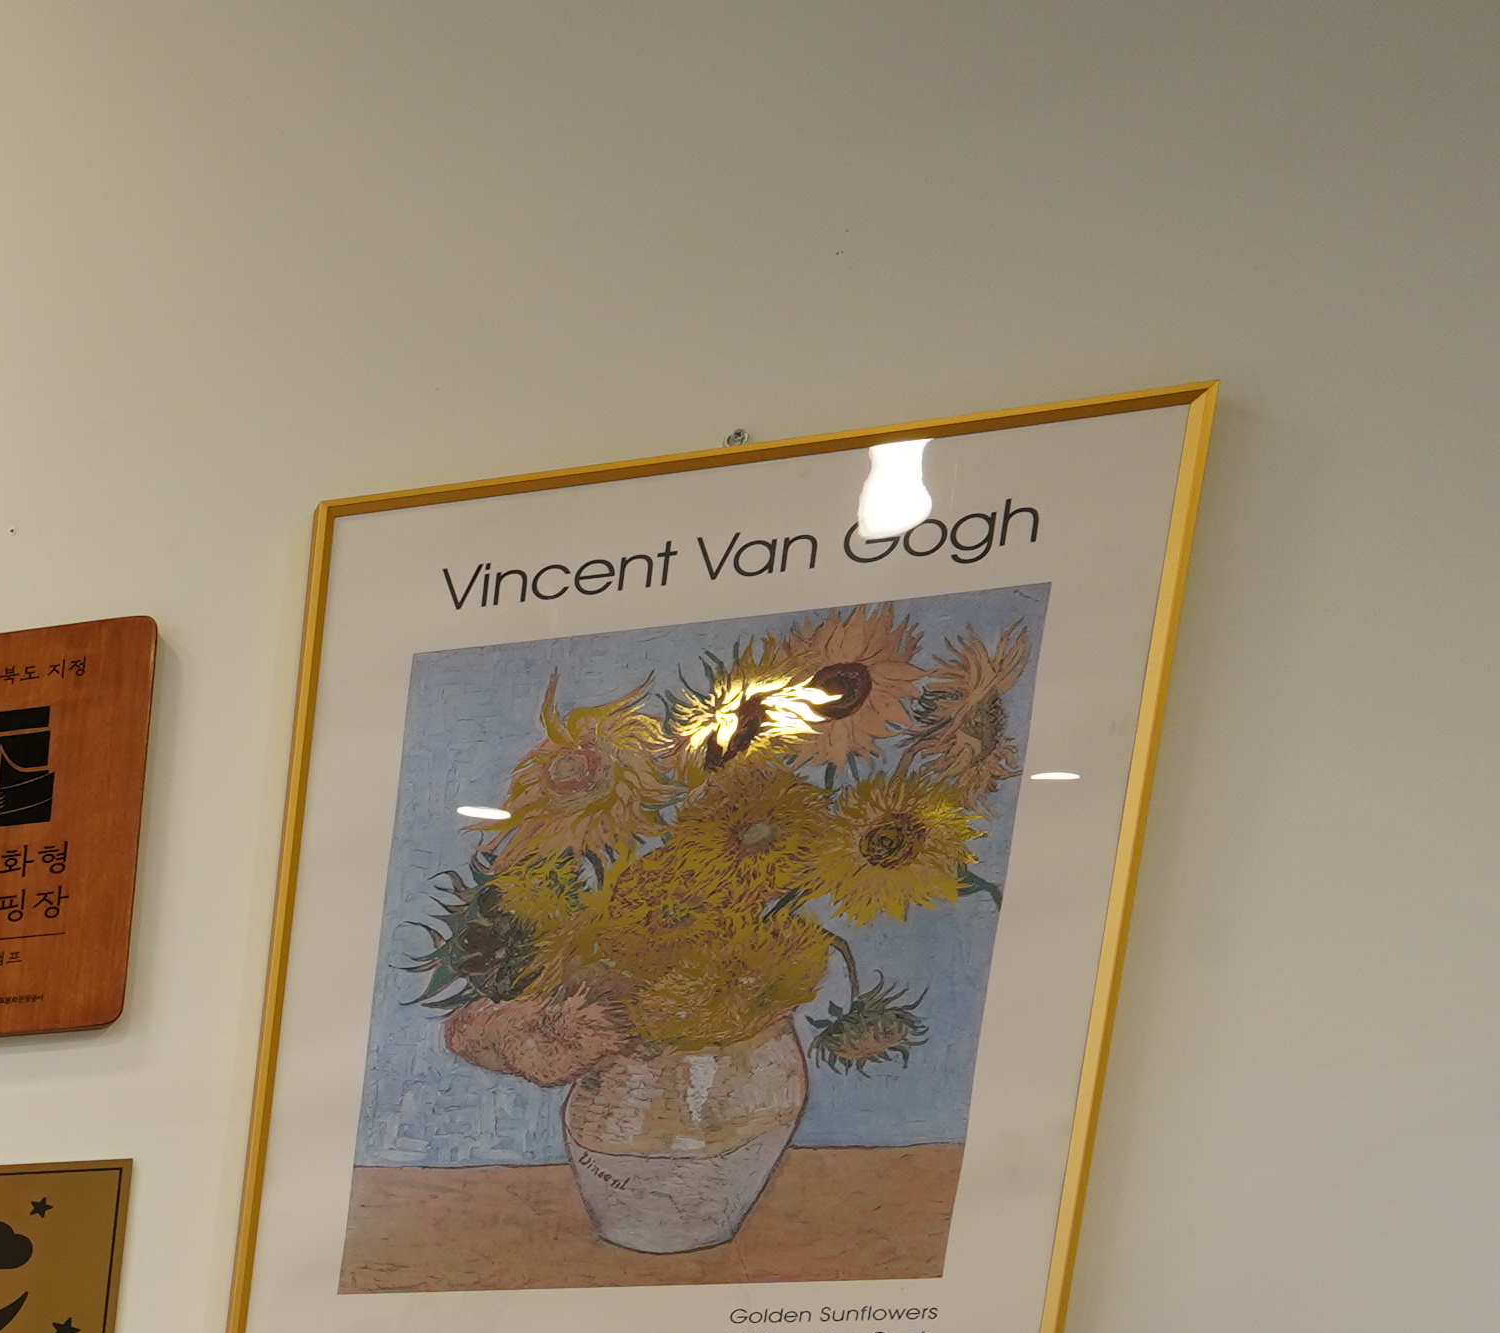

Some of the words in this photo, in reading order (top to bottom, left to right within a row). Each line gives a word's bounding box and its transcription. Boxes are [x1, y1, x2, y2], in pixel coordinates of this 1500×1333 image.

[441, 540, 679, 611] Vincent
[696, 532, 818, 581] Van
[843, 497, 1040, 564] Gogh
[47, 655, 88, 680] 지정
[729, 1307, 812, 1326] Golden
[819, 1304, 939, 1324] Sunflowers
